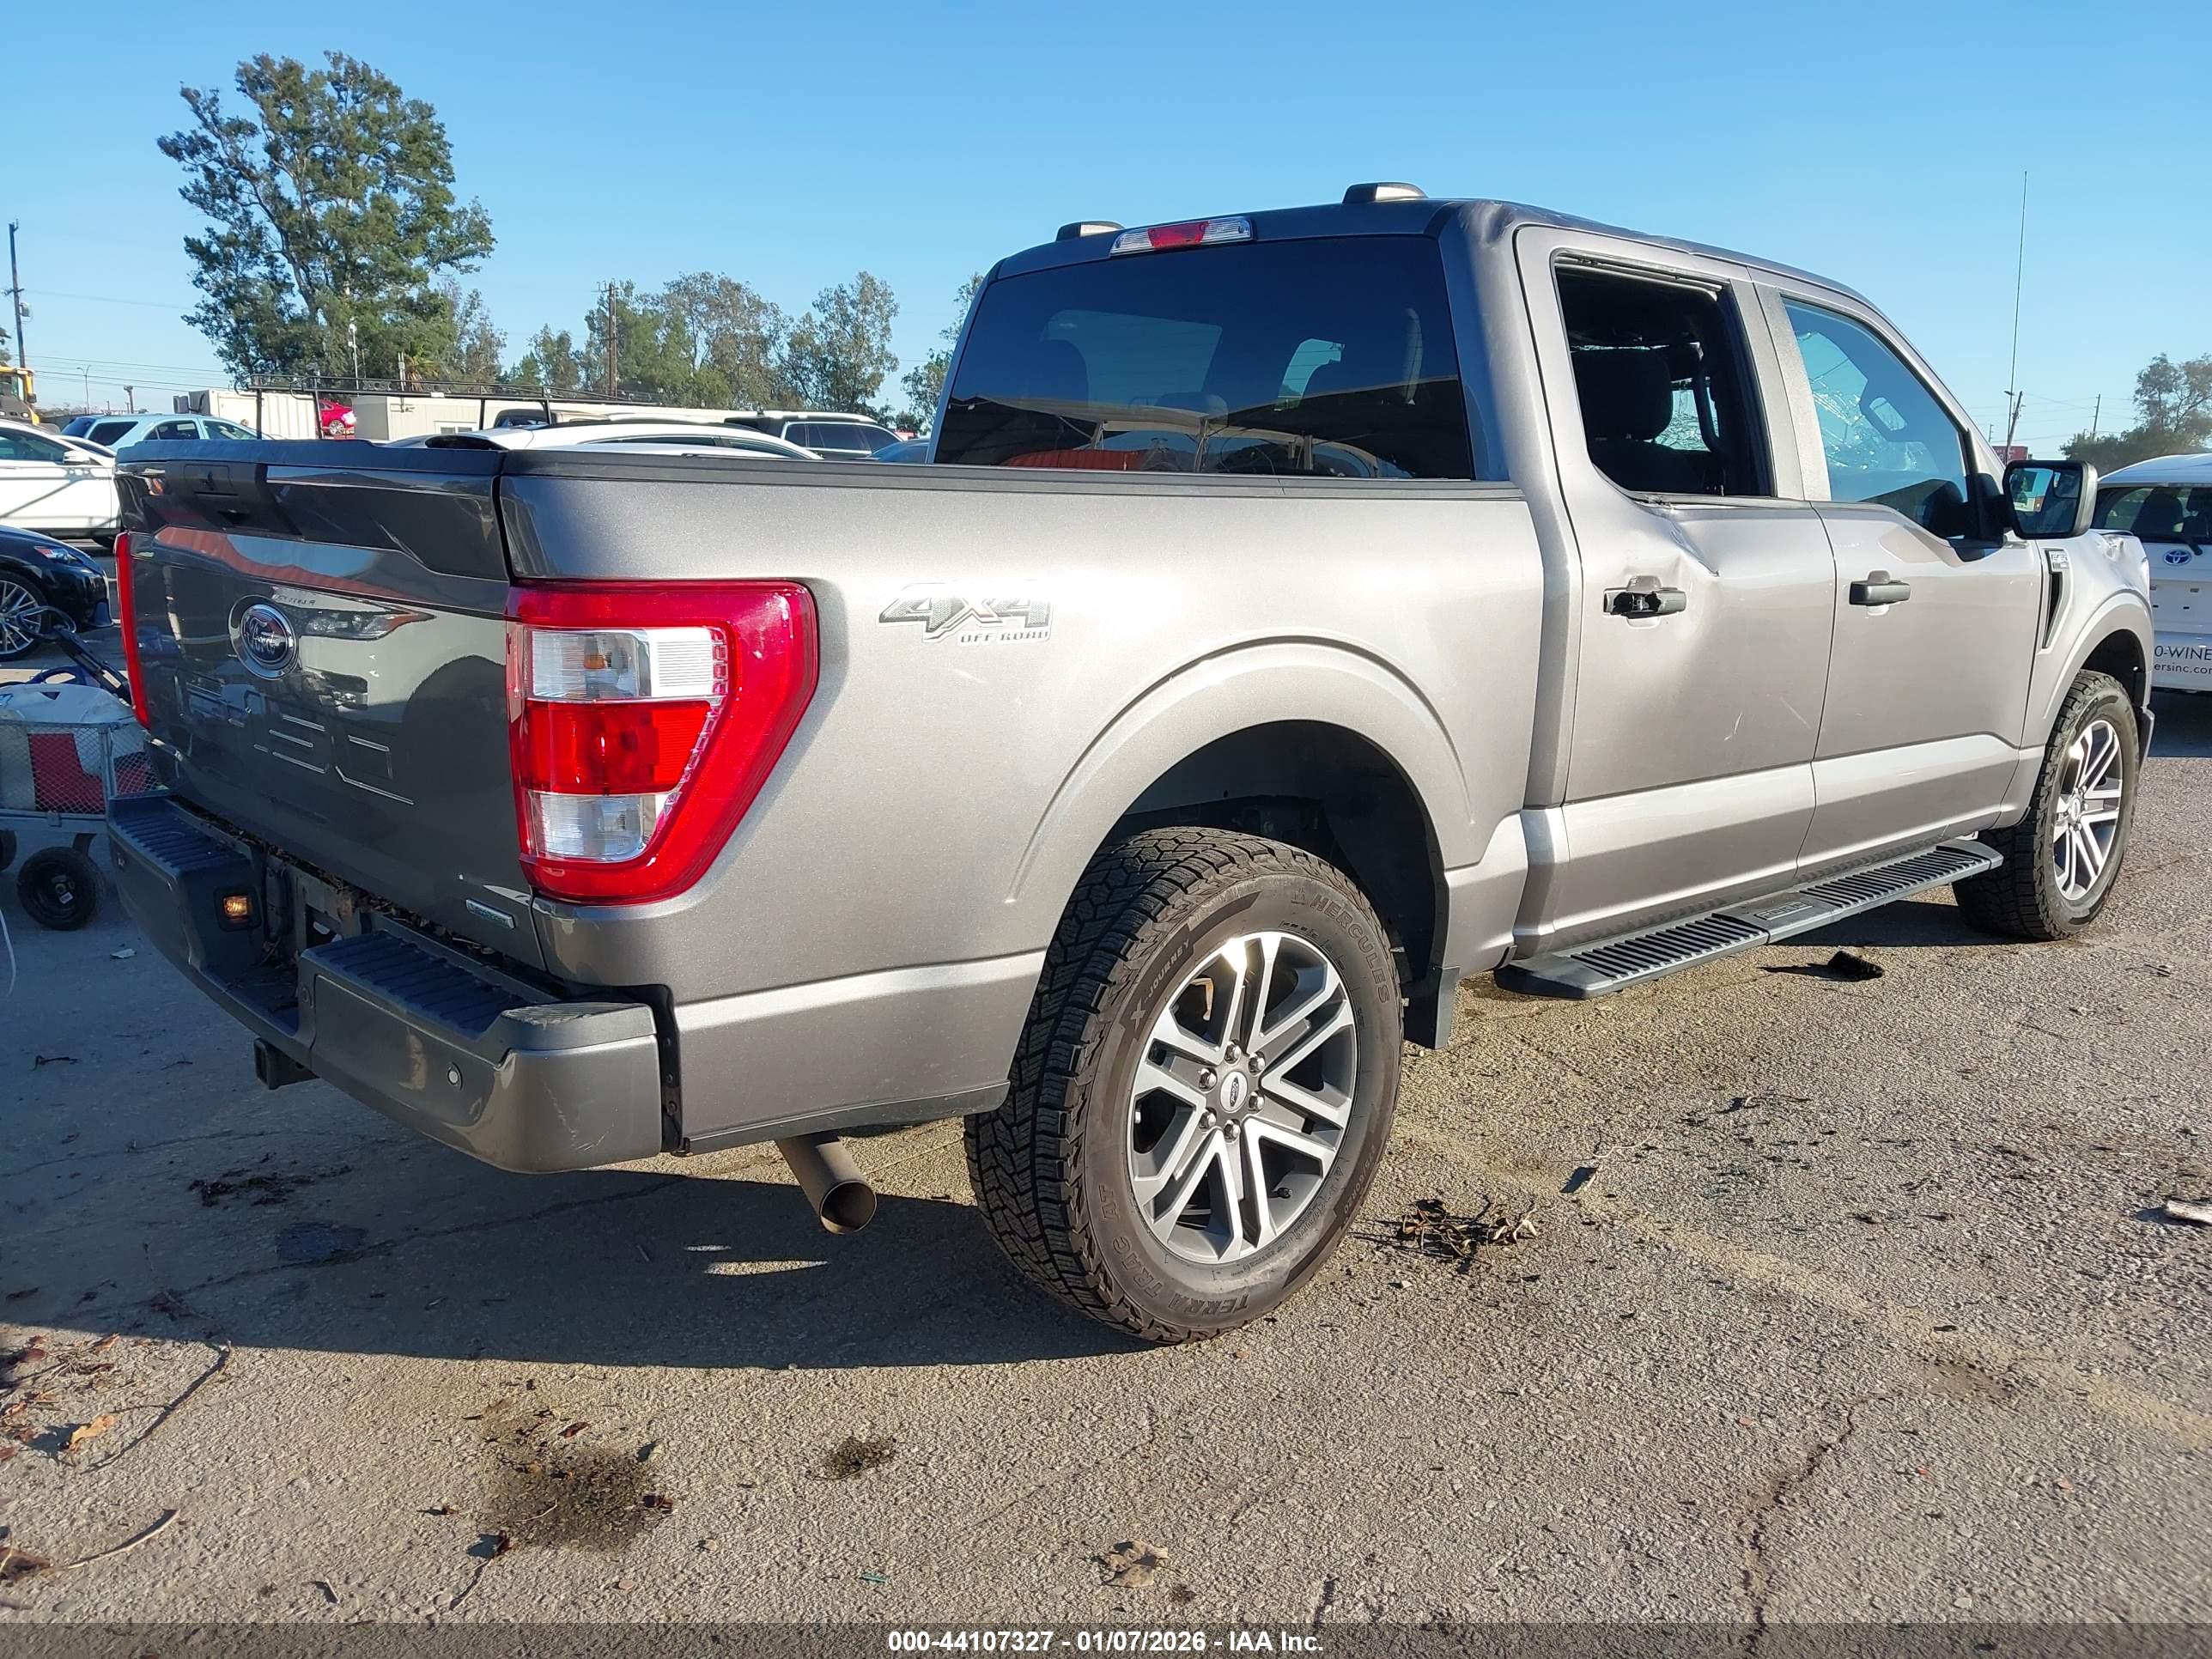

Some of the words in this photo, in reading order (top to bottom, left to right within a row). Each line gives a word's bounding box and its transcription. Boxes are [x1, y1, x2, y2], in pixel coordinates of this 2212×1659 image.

[248, 617, 276, 655] Ford
[960, 634, 994, 643] OFF
[1000, 630, 1049, 641] ROAD
[1310, 892, 1390, 1004] HERCULES
[1113, 1236, 1164, 1299] TRAC
[1167, 1291, 1249, 1316] TERRA
